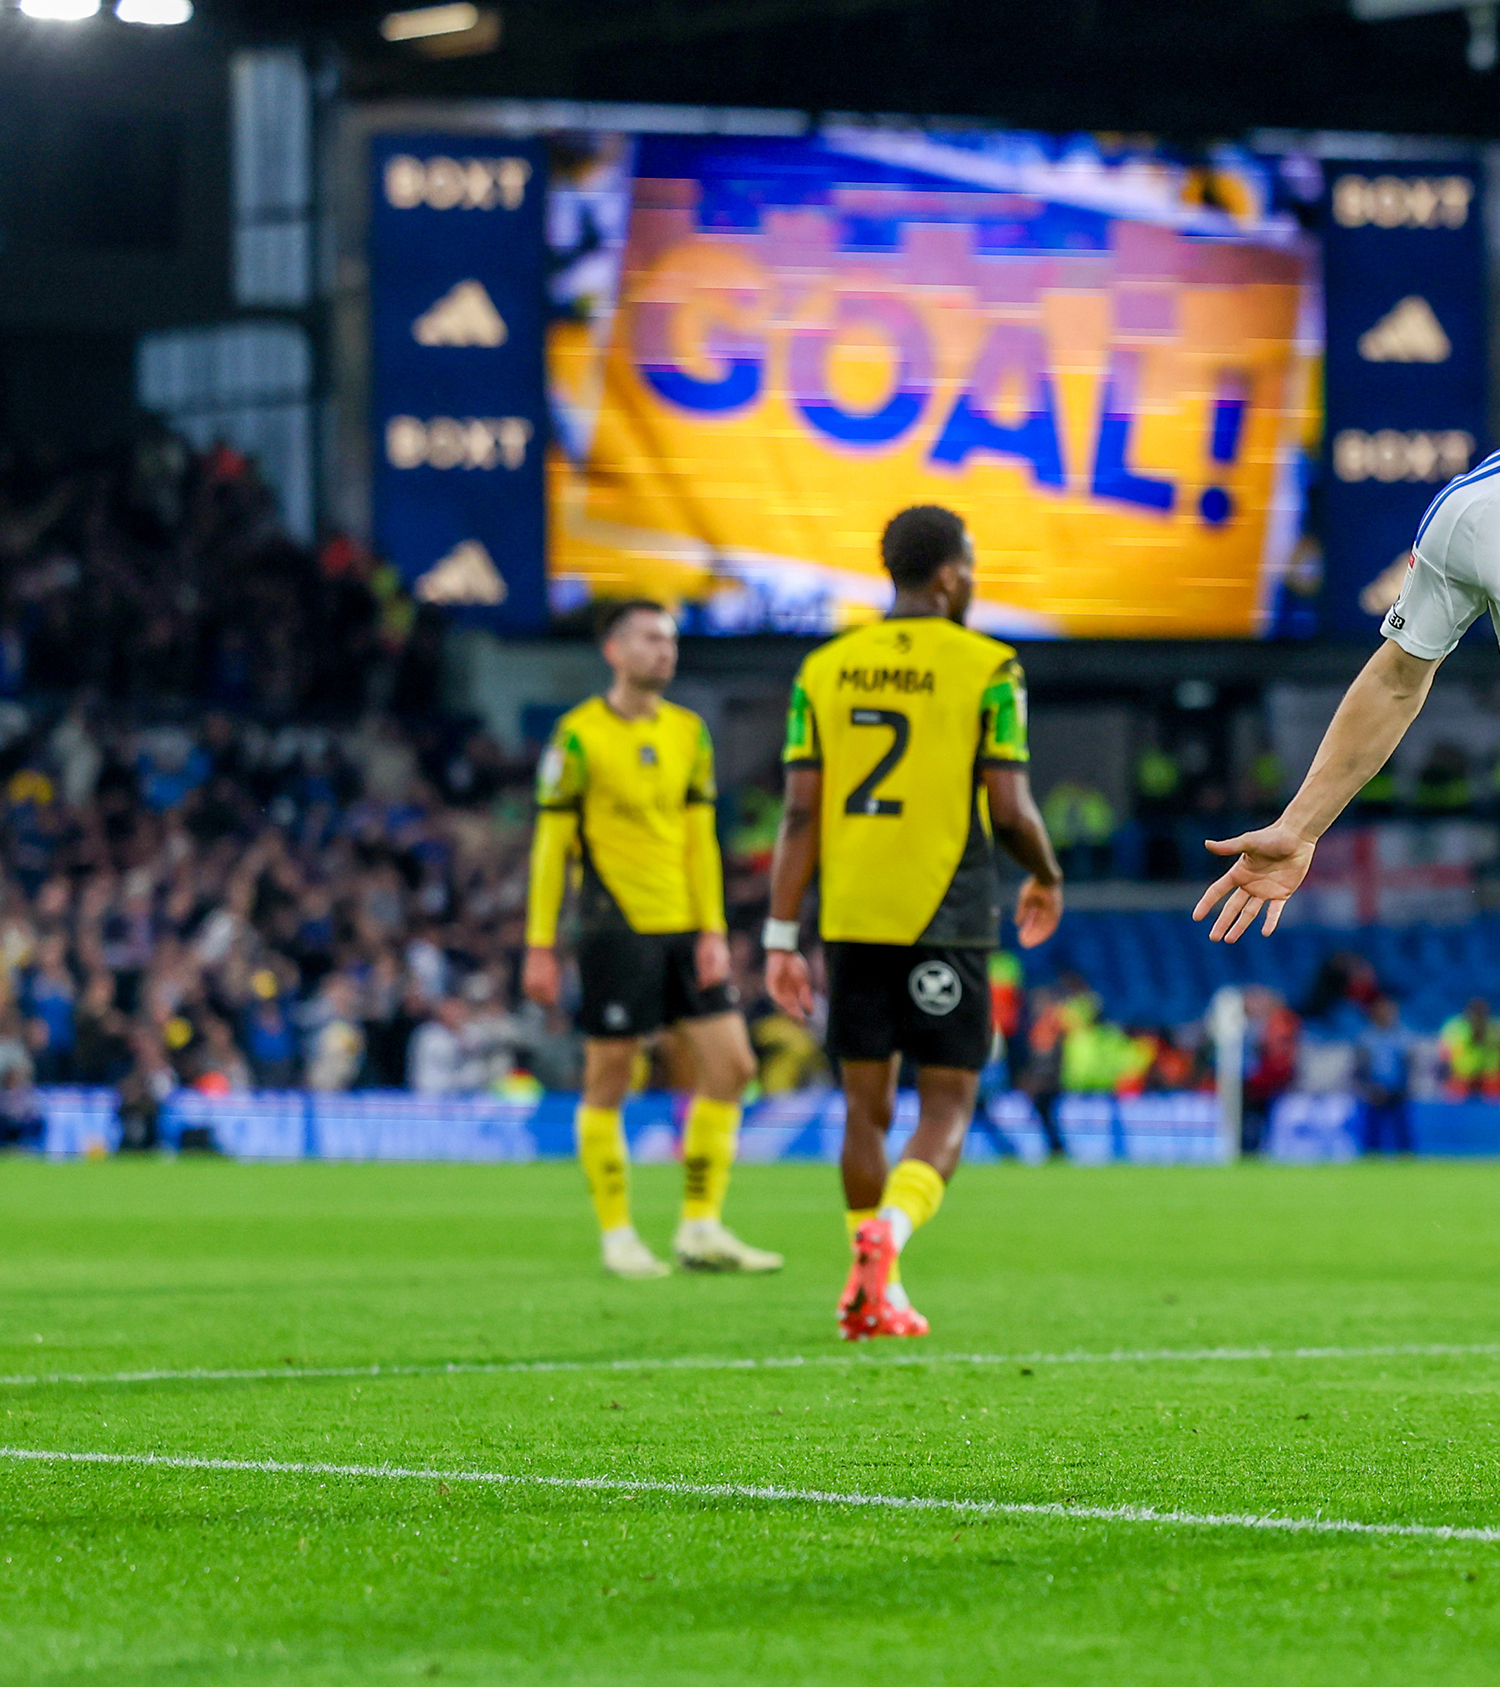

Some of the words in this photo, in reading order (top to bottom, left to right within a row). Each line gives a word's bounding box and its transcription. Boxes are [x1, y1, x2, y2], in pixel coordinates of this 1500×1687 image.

[630, 245, 1248, 526] GOAL!
[838, 667, 935, 695] MUMBA
[845, 707, 911, 815] 2
